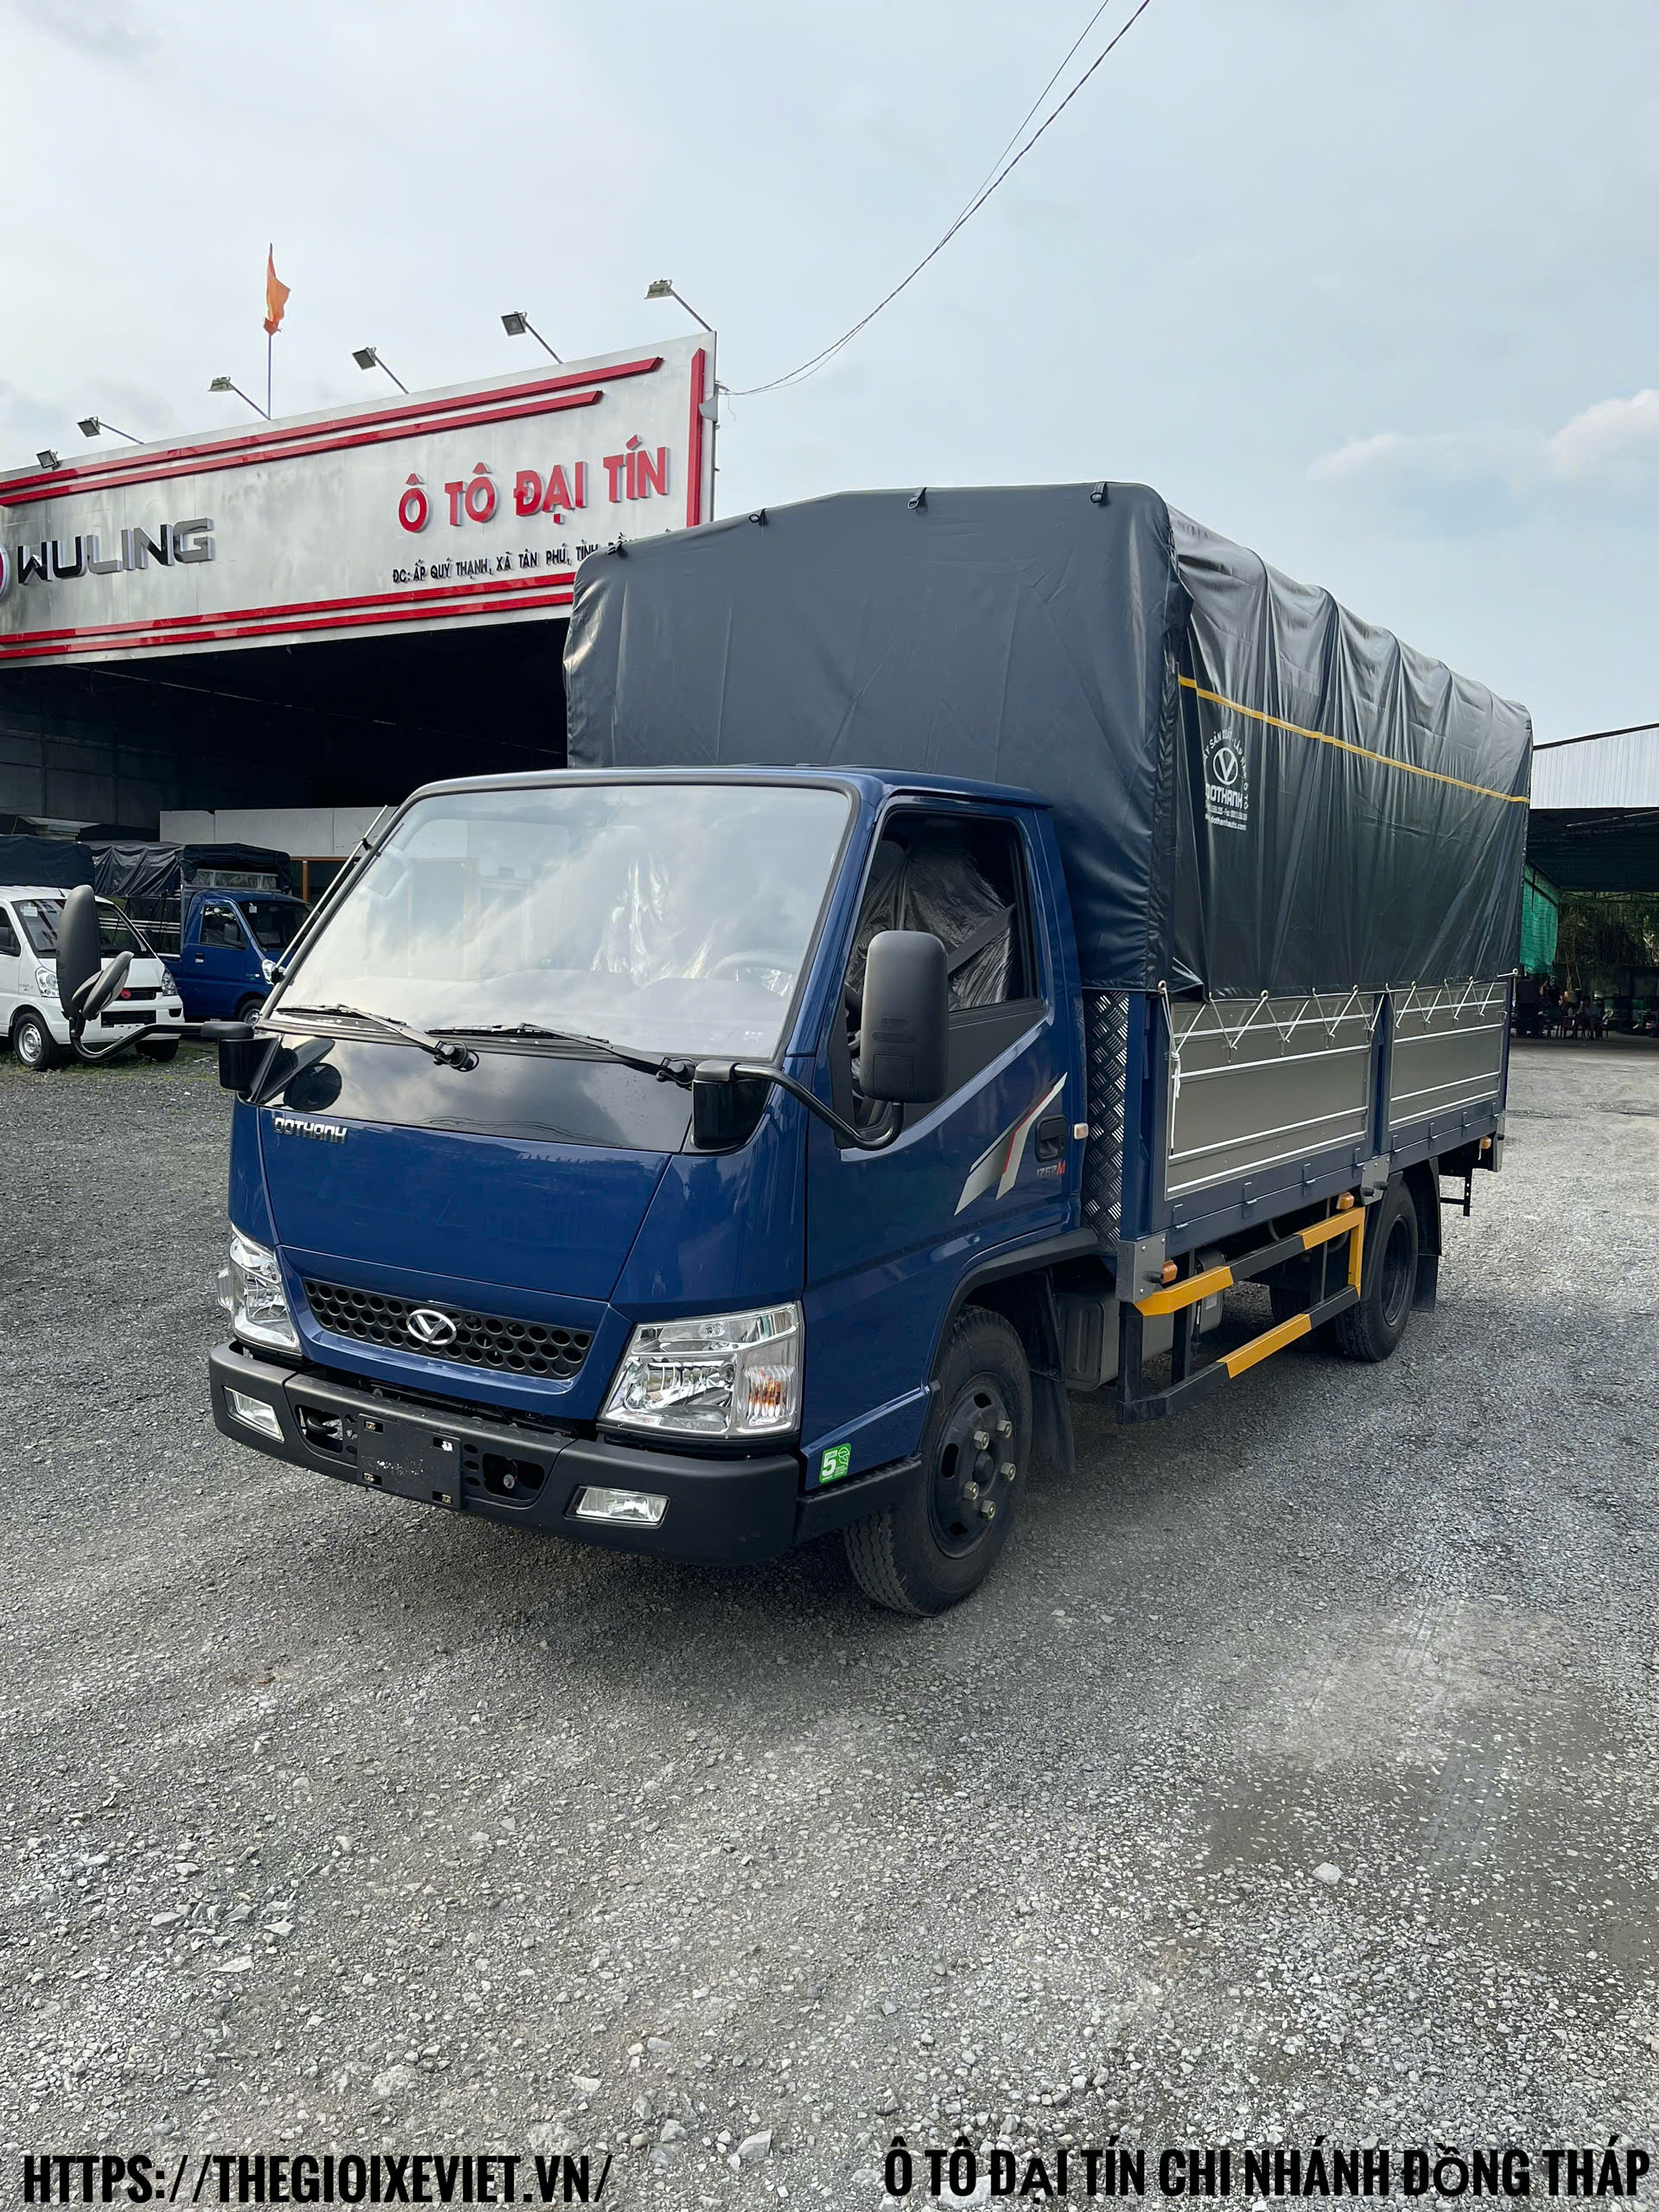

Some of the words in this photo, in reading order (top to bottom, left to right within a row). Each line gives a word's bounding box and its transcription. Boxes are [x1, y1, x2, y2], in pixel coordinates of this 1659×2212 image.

[398, 473, 430, 533] Ô
[444, 462, 498, 526] TÔ
[513, 461, 588, 524] ĐẠI
[603, 434, 671, 504] TÍN
[17, 518, 214, 585] WULING
[518, 548, 538, 569] TÂN
